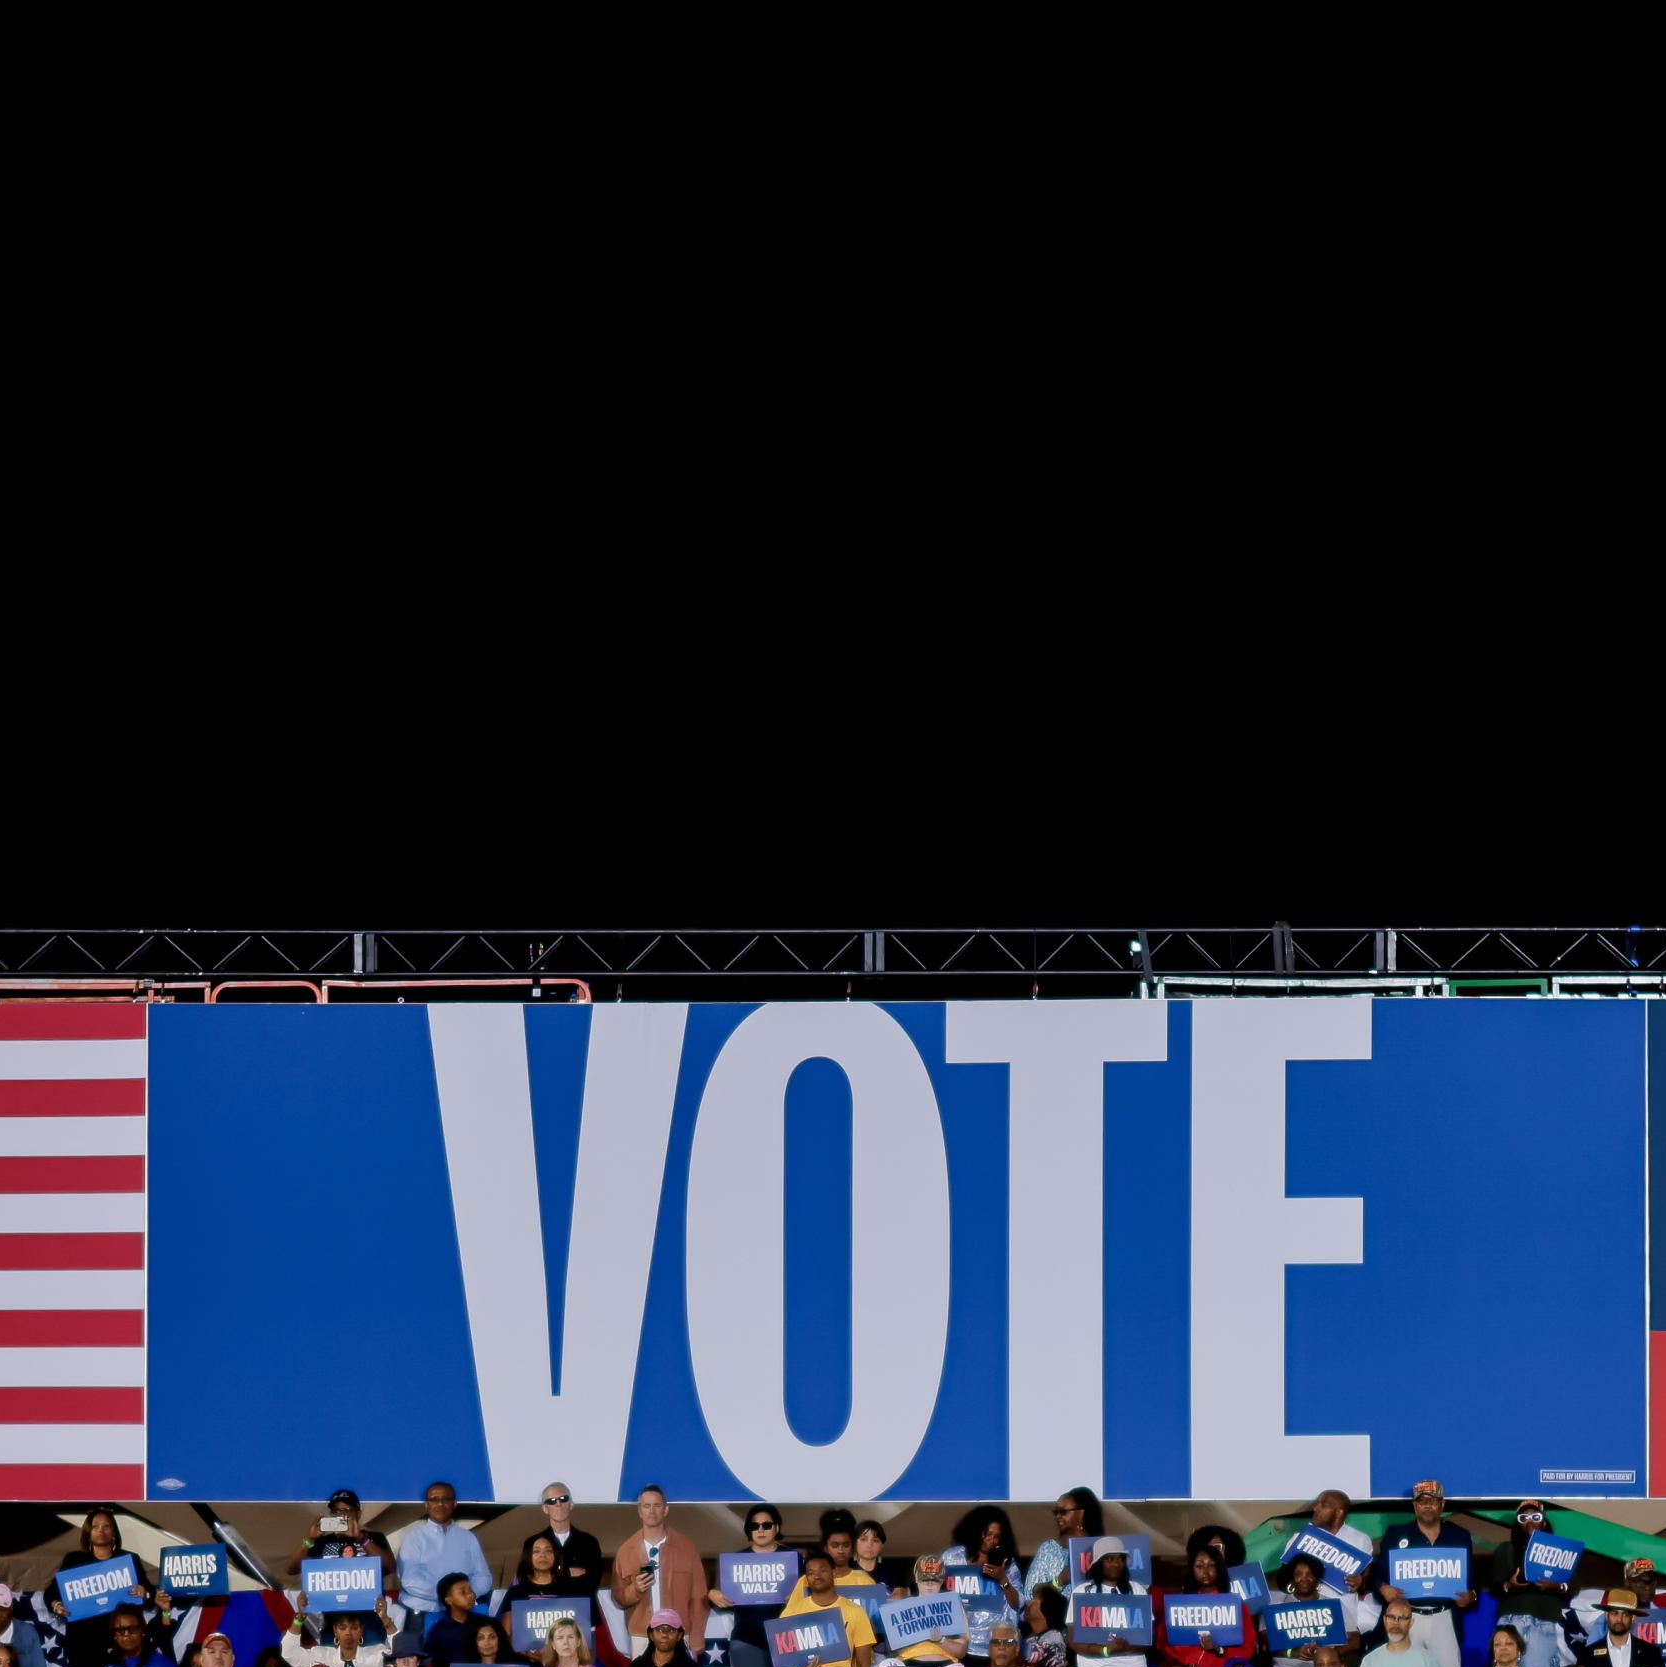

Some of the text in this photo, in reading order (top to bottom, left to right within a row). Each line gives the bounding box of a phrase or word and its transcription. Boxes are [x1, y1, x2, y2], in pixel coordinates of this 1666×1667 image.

[428, 1001, 1372, 1503] VOTE
[164, 1554, 217, 1576] HARRIS
[1297, 1535, 1361, 1574] FREEDOM
[1529, 1543, 1578, 1570] FREEDOM
[733, 1564, 785, 1582] HARRIS
[1395, 1559, 1462, 1580] FREEDOM
[65, 1568, 132, 1601] FREEDOM
[170, 1575, 210, 1588] WALZ
[308, 1570, 375, 1592] FREEDOM
[741, 1582, 778, 1593] WALZ
[891, 1603, 953, 1626] A NEW WAY
[897, 1614, 953, 1637] FORWARD
[1080, 1606, 1144, 1628] KAMALA
[1170, 1605, 1237, 1626] FREEDOM
[1274, 1608, 1333, 1630] HARRIS
[775, 1624, 841, 1654] KAMALA
[1286, 1625, 1327, 1639] WALZ
